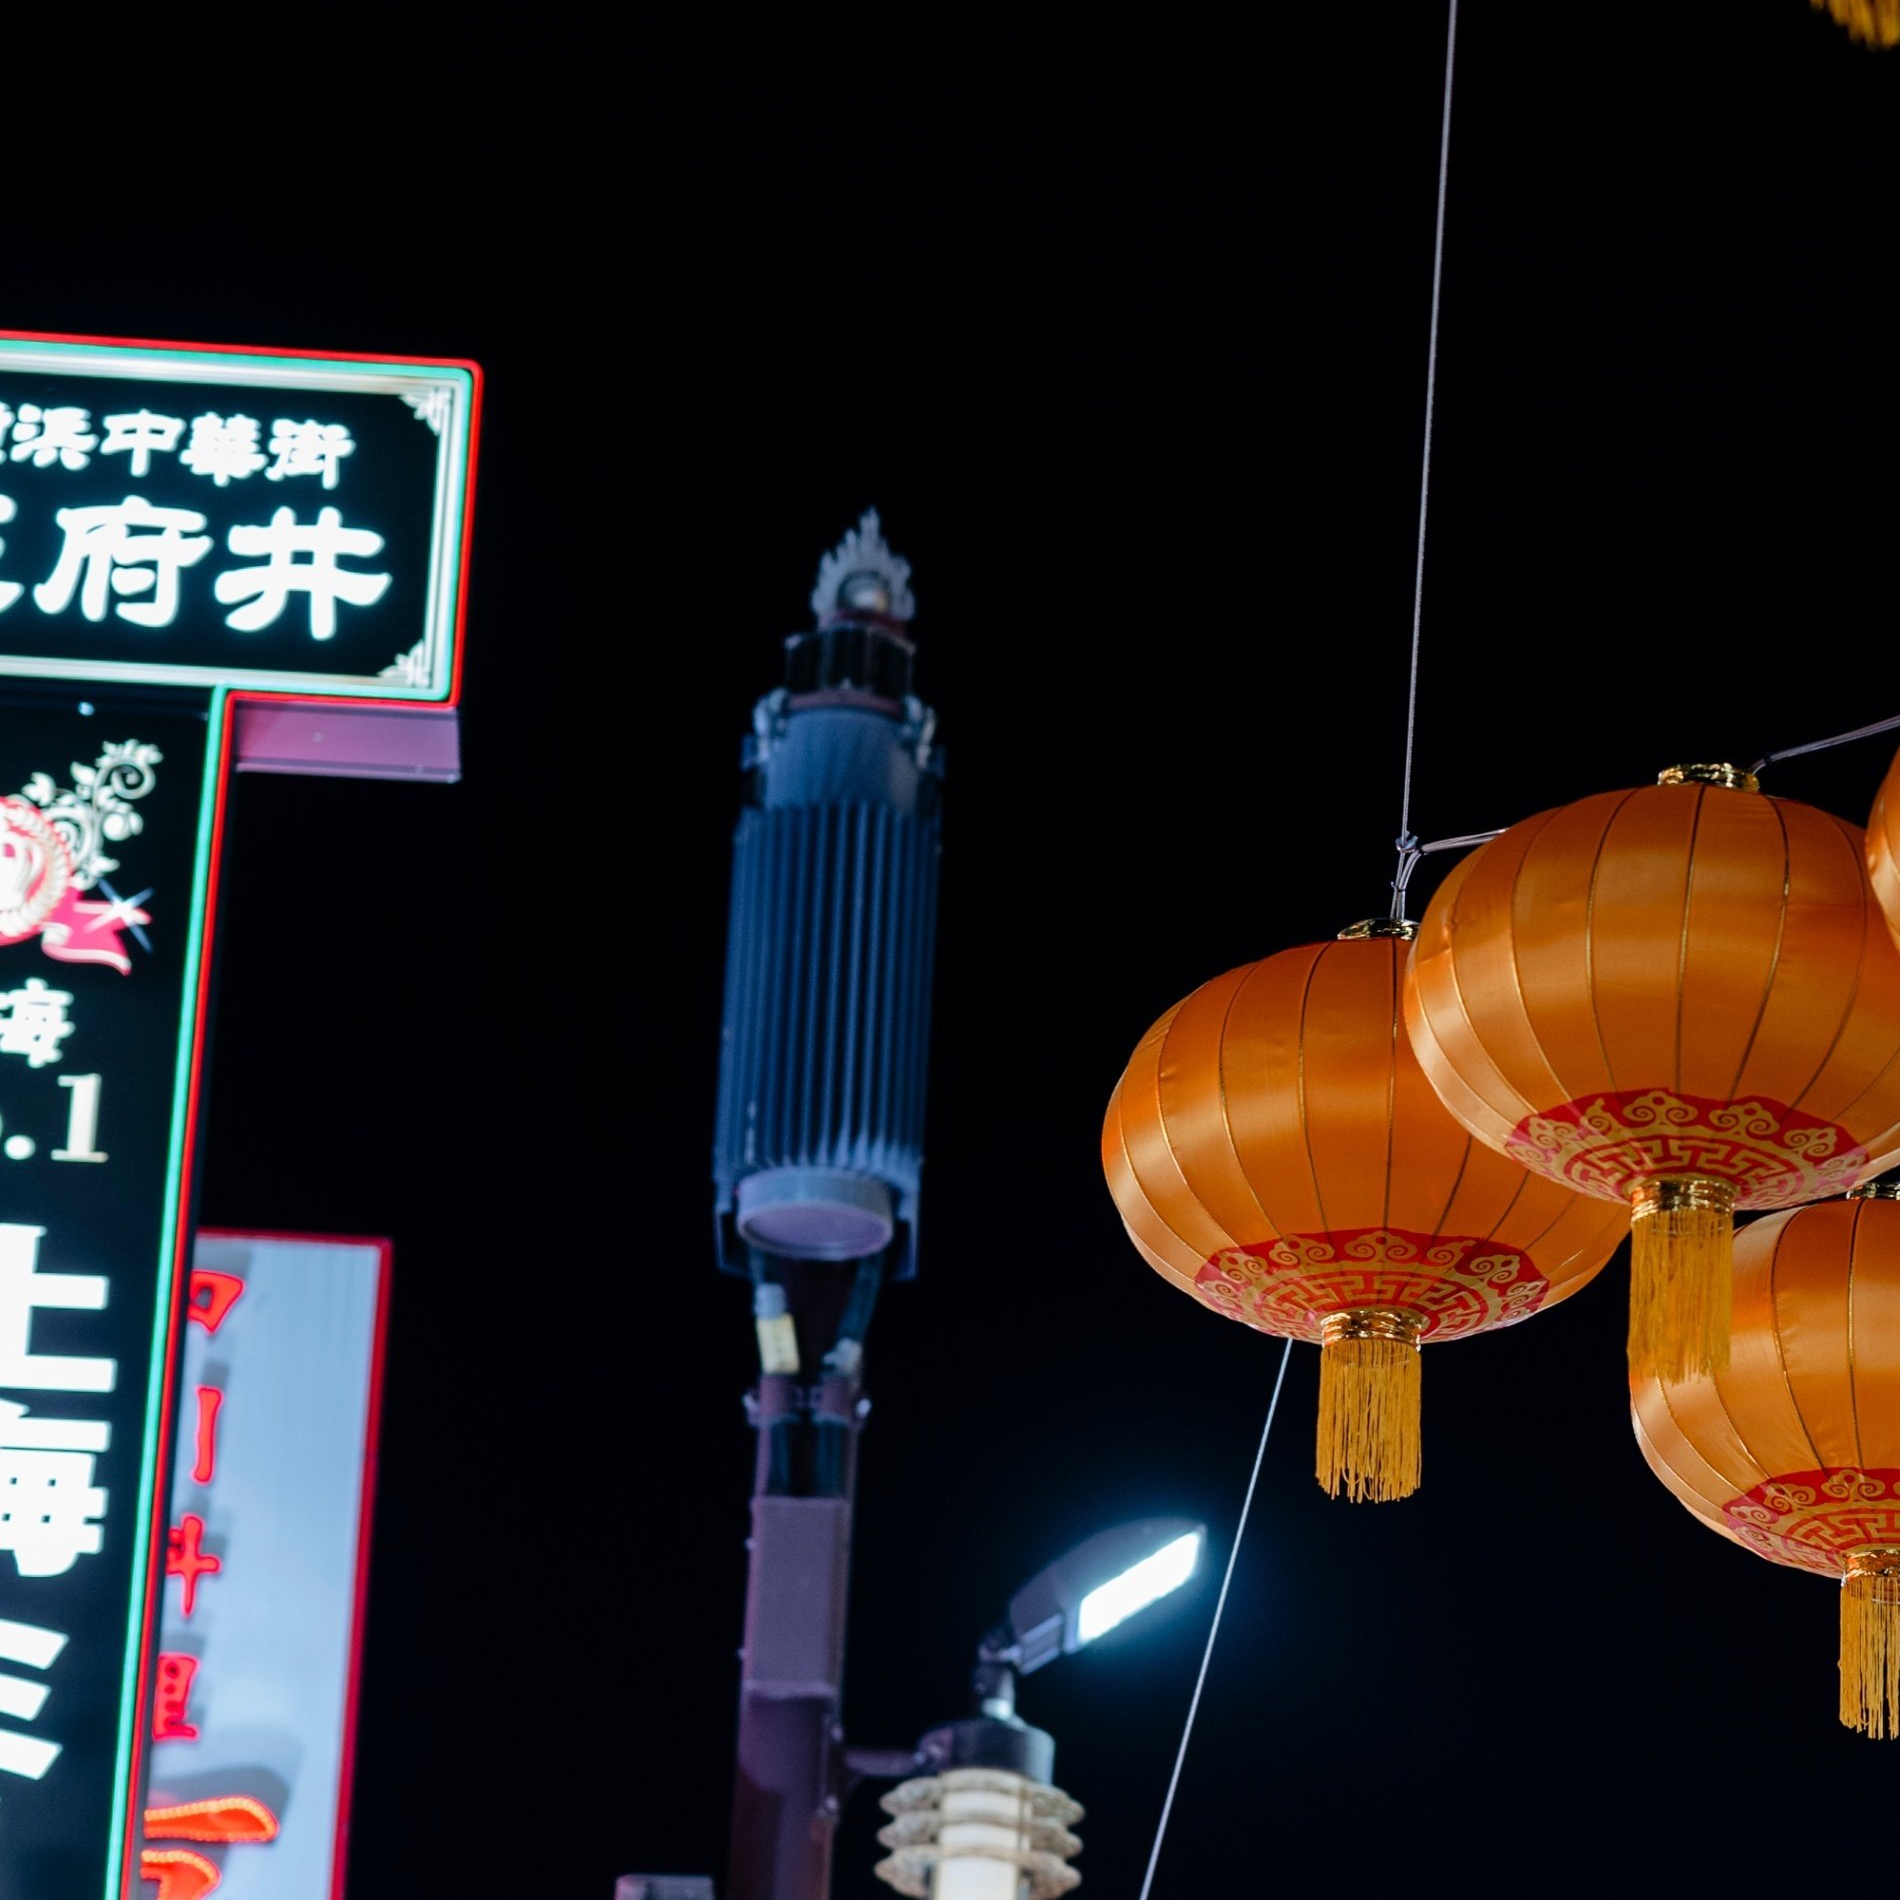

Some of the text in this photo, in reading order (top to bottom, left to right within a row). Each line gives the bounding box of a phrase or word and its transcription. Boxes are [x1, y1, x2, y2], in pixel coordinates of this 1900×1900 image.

[0, 403, 355, 489] 浜中華街
[0, 495, 392, 640] 府井
